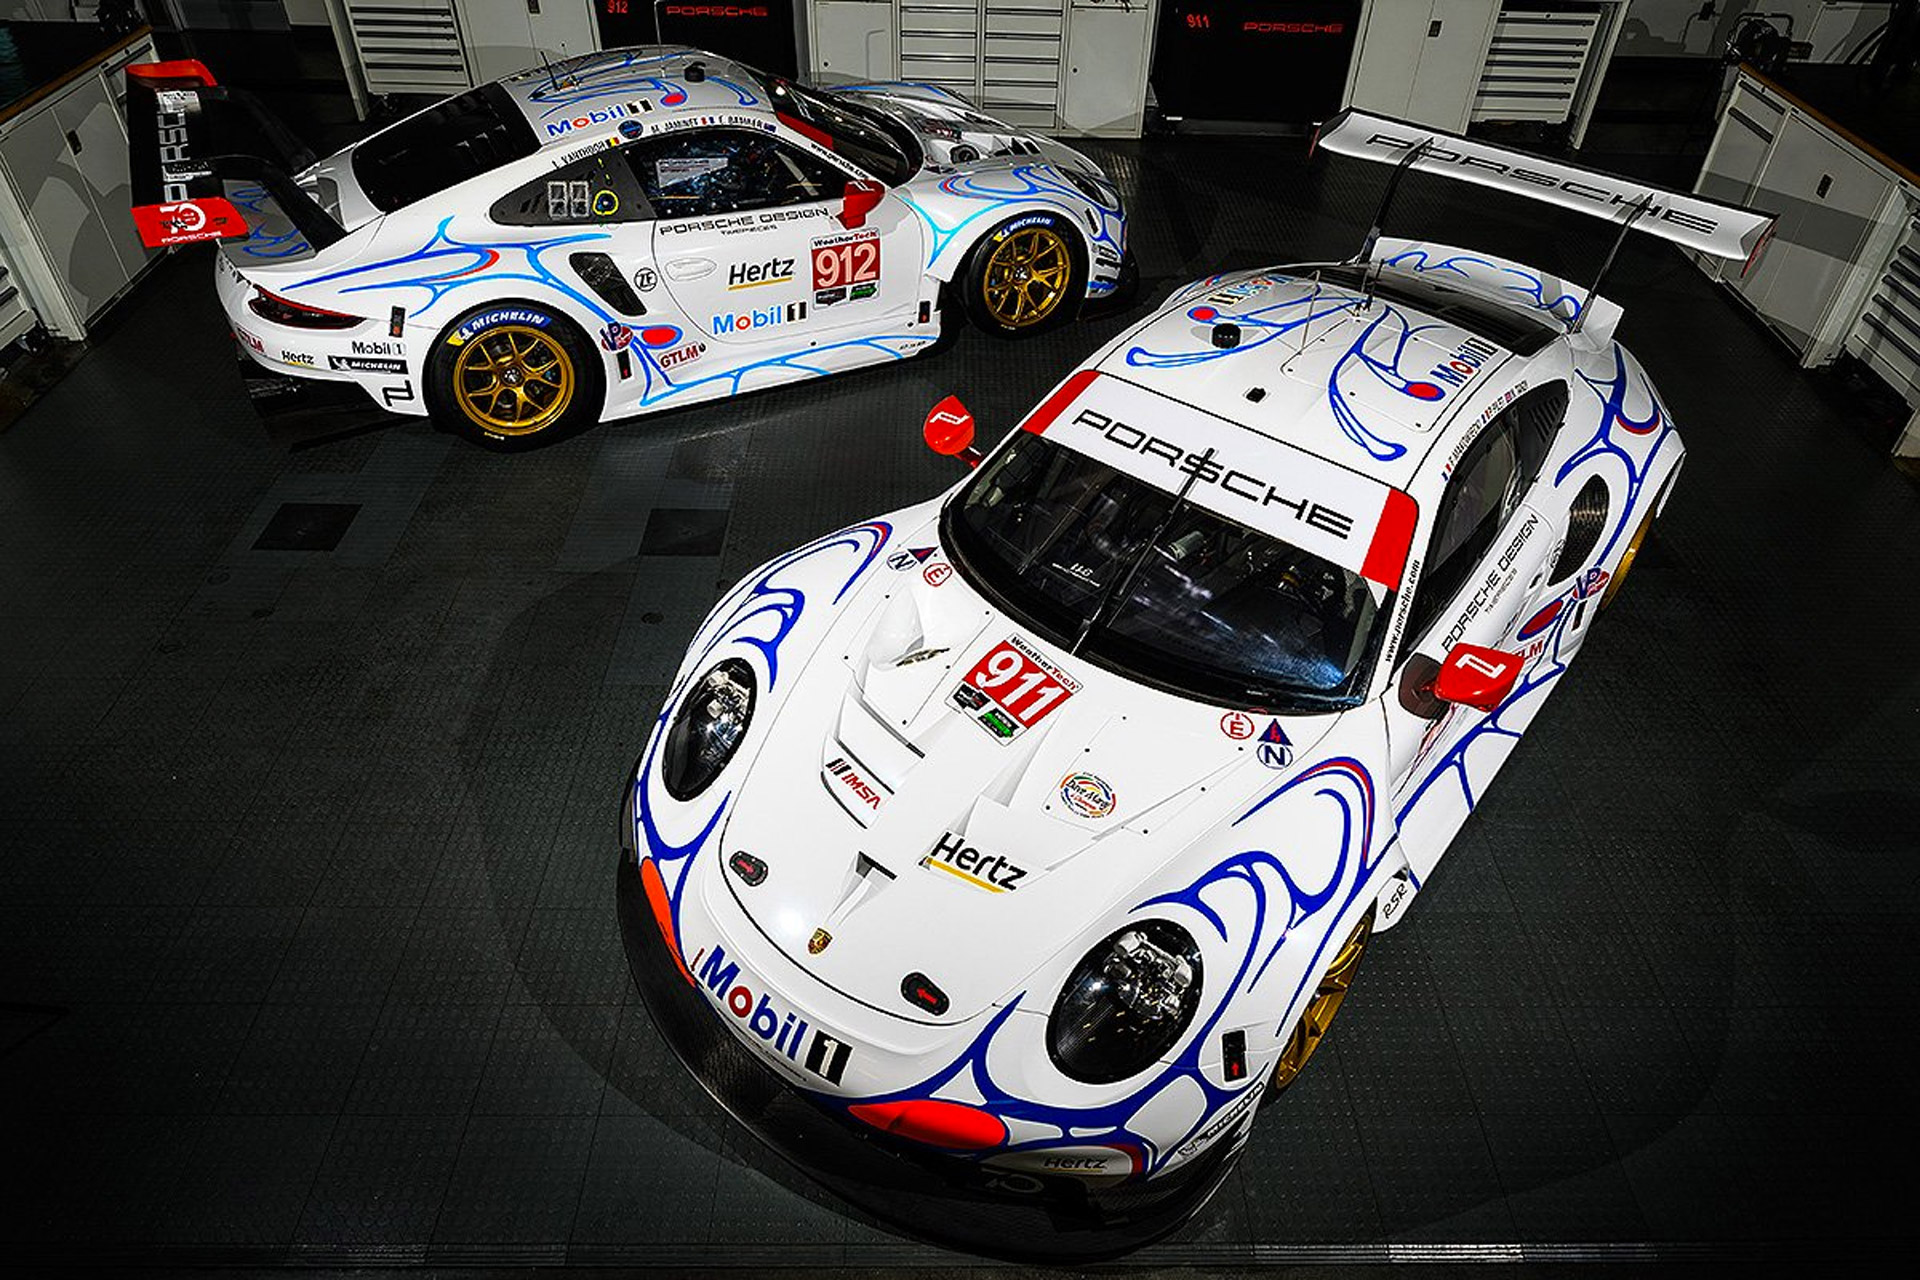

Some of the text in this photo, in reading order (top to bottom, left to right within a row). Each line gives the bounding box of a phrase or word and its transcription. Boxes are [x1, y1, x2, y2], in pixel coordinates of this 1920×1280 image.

[608, 1, 628, 14] 912
[666, 6, 768, 17] PORSCHE
[1187, 14, 1210, 28] 911
[1243, 22, 1343, 33] PORSCHE
[547, 105, 625, 136] Mobil
[1366, 133, 1719, 236] PORSCHE
[660, 207, 829, 235] PORSCHE DESIGN
[728, 257, 795, 285] Hertz
[816, 243, 876, 287] 912
[472, 311, 544, 328] MICHELIN
[712, 306, 781, 335] Mobil
[352, 341, 391, 356] Mobil
[600, 321, 621, 351] VP
[281, 350, 315, 365] Hertz
[351, 361, 401, 371] MICHELIN
[660, 345, 698, 368] GTLM
[1430, 343, 1489, 388] Mobil
[1072, 409, 1354, 539] PORSCHE
[1441, 513, 1539, 653] PORSCHE DESIGN
[1576, 568, 1601, 599] VP
[1385, 559, 1420, 662] www.porsche.com
[1011, 636, 1080, 691] WeatherTech
[976, 650, 1064, 722] 911
[841, 772, 881, 810] IMSA
[930, 832, 1028, 891] Hertz
[1382, 883, 1408, 919] RSR
[699, 944, 809, 1061] Mobil
[1207, 1084, 1263, 1137] MICHELIN
[1043, 1155, 1108, 1169] Hertz
